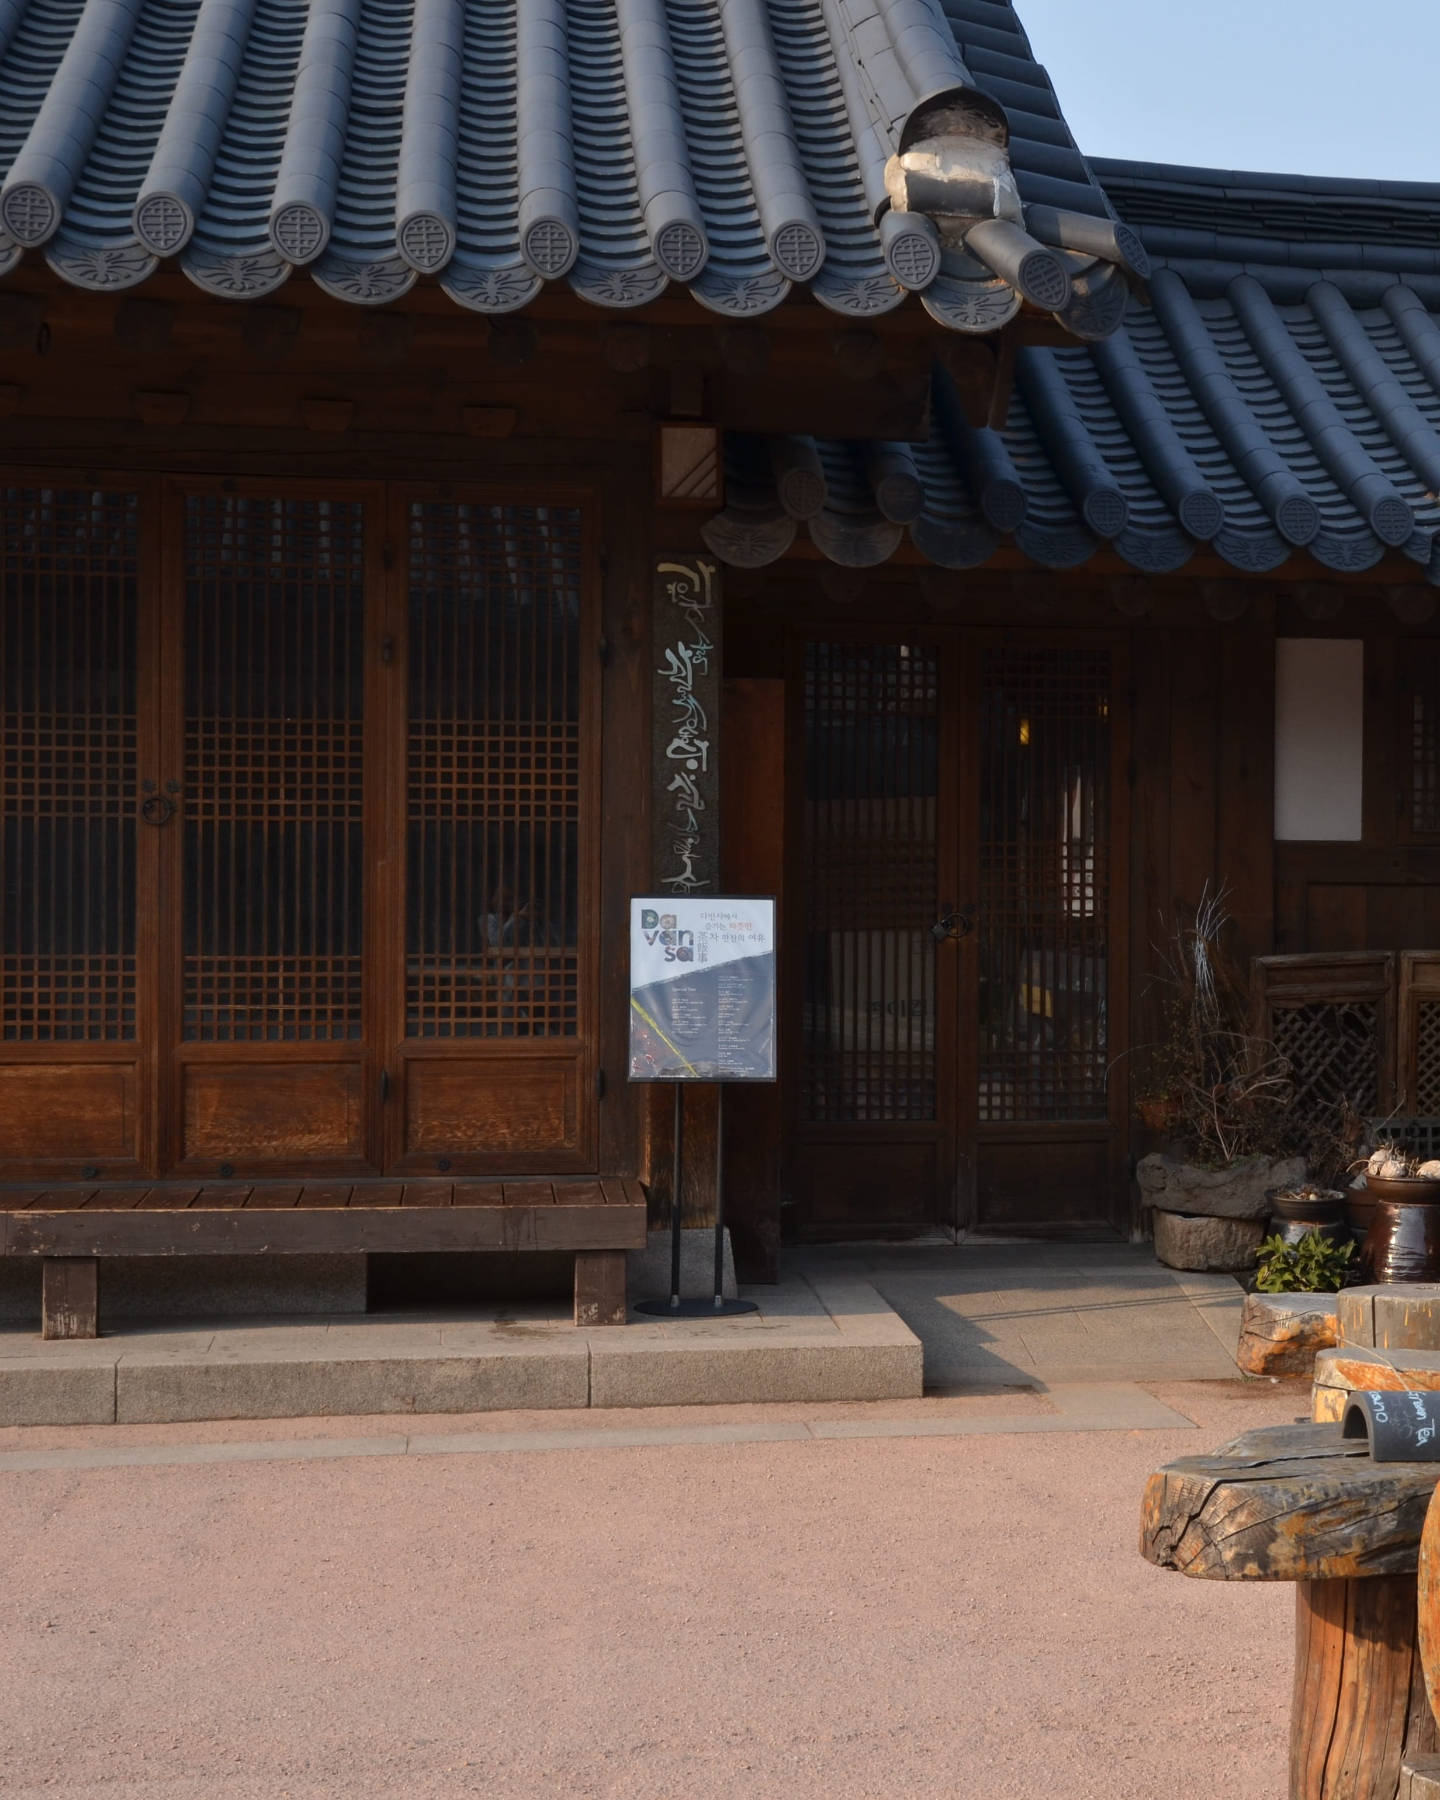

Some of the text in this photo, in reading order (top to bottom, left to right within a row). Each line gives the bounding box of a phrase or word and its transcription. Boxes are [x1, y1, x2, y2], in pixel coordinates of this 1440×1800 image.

[641, 909, 677, 929] Da
[643, 930, 694, 946] van
[664, 946, 694, 962] sa
[1416, 1418, 1435, 1447] Tea
